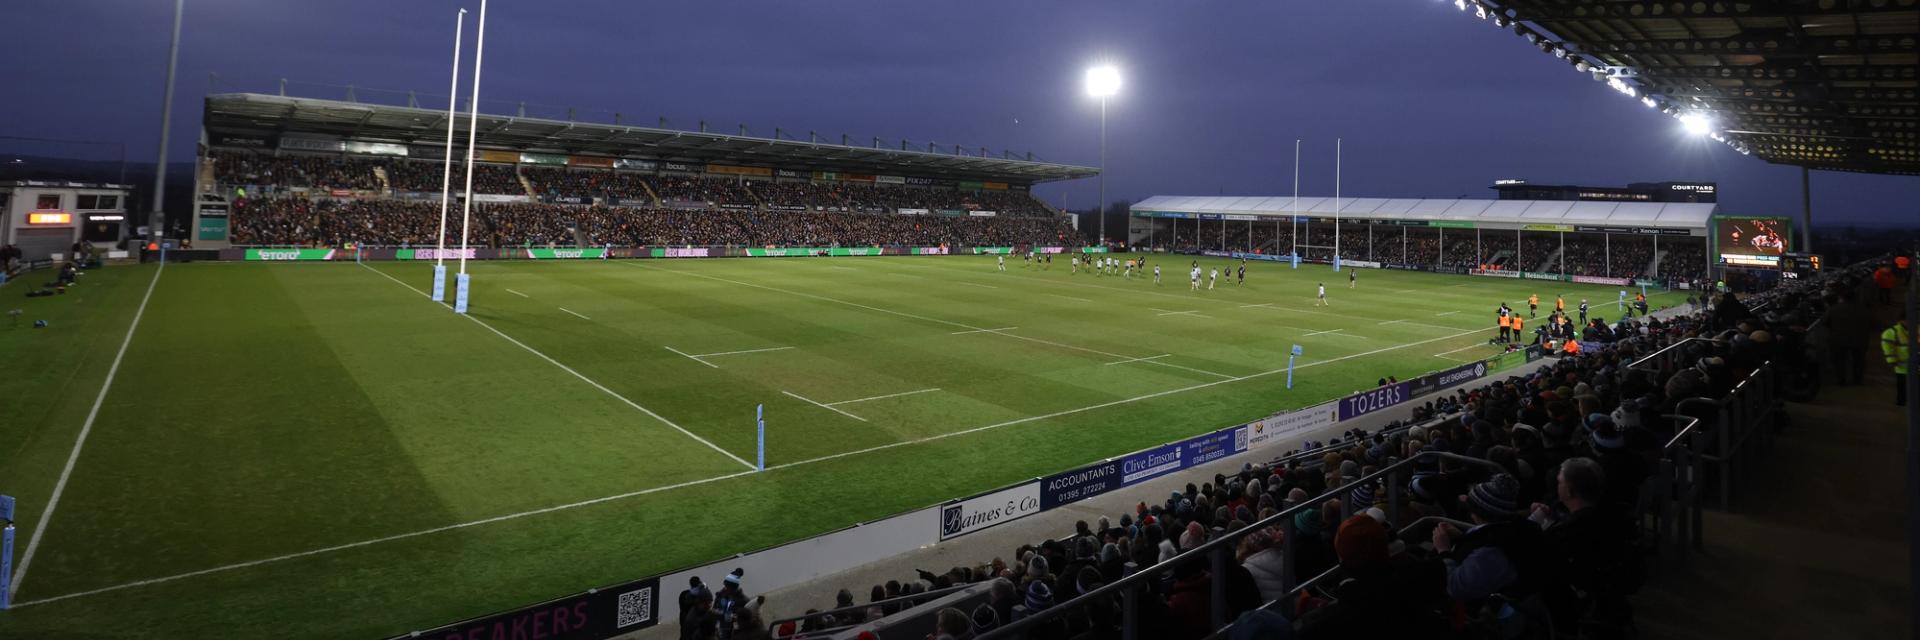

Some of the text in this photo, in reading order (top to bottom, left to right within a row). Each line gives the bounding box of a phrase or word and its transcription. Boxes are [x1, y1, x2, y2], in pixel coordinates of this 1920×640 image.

[1525, 272, 1557, 280] Heineken
[1350, 386, 1400, 416] TOZERS
[1124, 459, 1146, 474] Clive
[1148, 452, 1175, 468] Emson
[1049, 465, 1115, 492] ACCOUNTANTS
[1058, 482, 1105, 502] 01395 272224
[944, 496, 1039, 535] Baines & Co.
